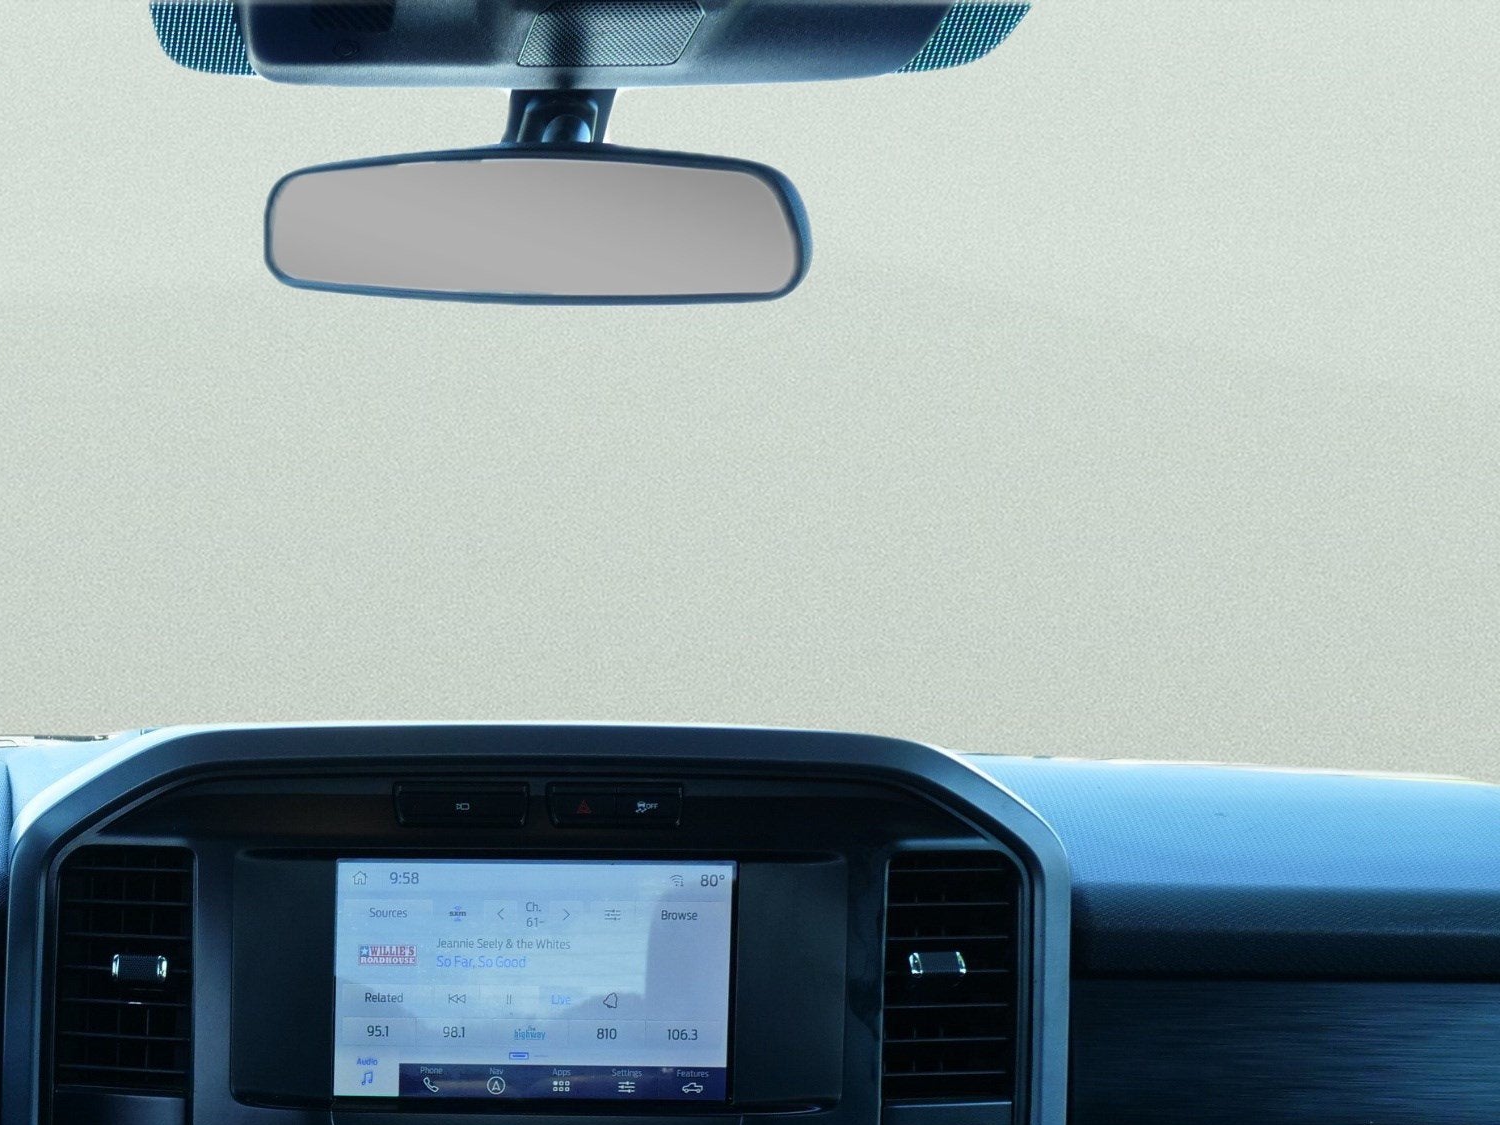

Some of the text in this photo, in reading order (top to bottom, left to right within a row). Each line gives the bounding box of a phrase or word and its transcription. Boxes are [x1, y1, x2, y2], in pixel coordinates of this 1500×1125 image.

[389, 872, 419, 885] 9:58
[700, 874, 725, 887] 80°
[525, 901, 542, 913] Ch.
[369, 907, 408, 919] Sources
[661, 910, 698, 921] Browse
[370, 945, 415, 956] WILLIE'S
[436, 938, 571, 952] Jeannie Seely & the Whites
[360, 956, 416, 965] ROADHOUSE
[436, 956, 526, 970] So Far, So Good
[365, 992, 404, 1003] Related
[551, 995, 571, 1005] Live
[367, 1025, 389, 1038] 95.1
[443, 1026, 466, 1038] 98.1
[514, 1028, 546, 1041] highway
[596, 1028, 617, 1040] 810
[668, 1029, 698, 1041] 106.3
[356, 1057, 378, 1066] Audio
[420, 1066, 443, 1075] Phone
[489, 1067, 503, 1075] Nav
[552, 1068, 572, 1078] Apps
[612, 1069, 643, 1079] Settings
[676, 1069, 709, 1079] Features
